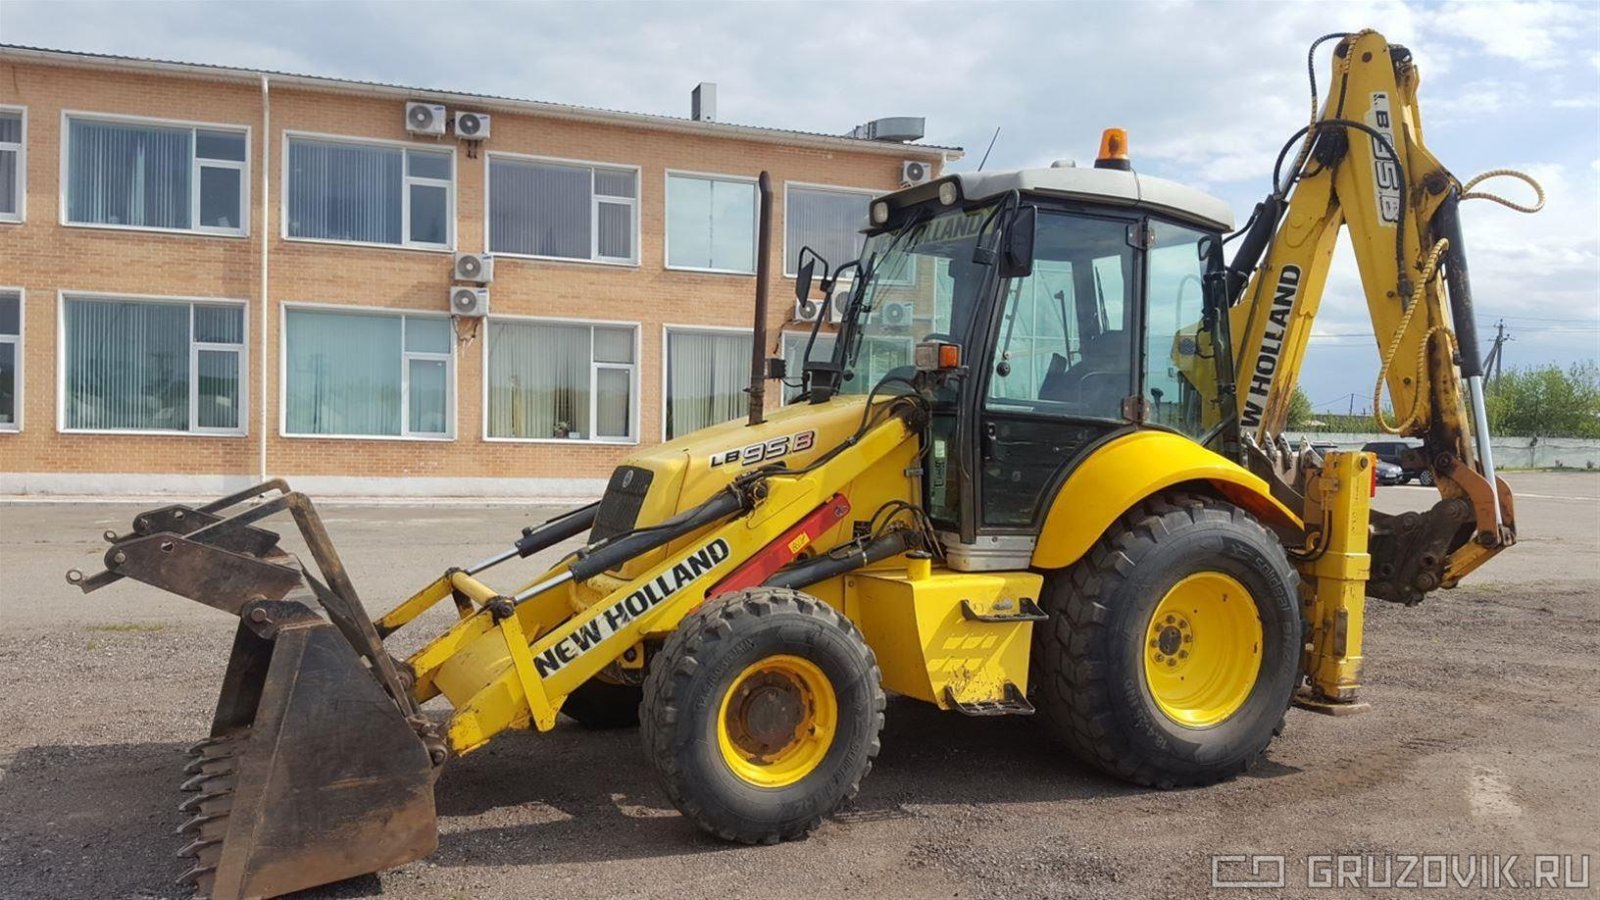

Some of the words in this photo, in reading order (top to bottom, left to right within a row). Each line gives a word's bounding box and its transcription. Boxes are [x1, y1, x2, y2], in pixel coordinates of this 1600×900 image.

[1249, 265, 1301, 397] HOLLAND
[533, 619, 602, 679] NEW
[603, 538, 730, 632] HOLLAND
